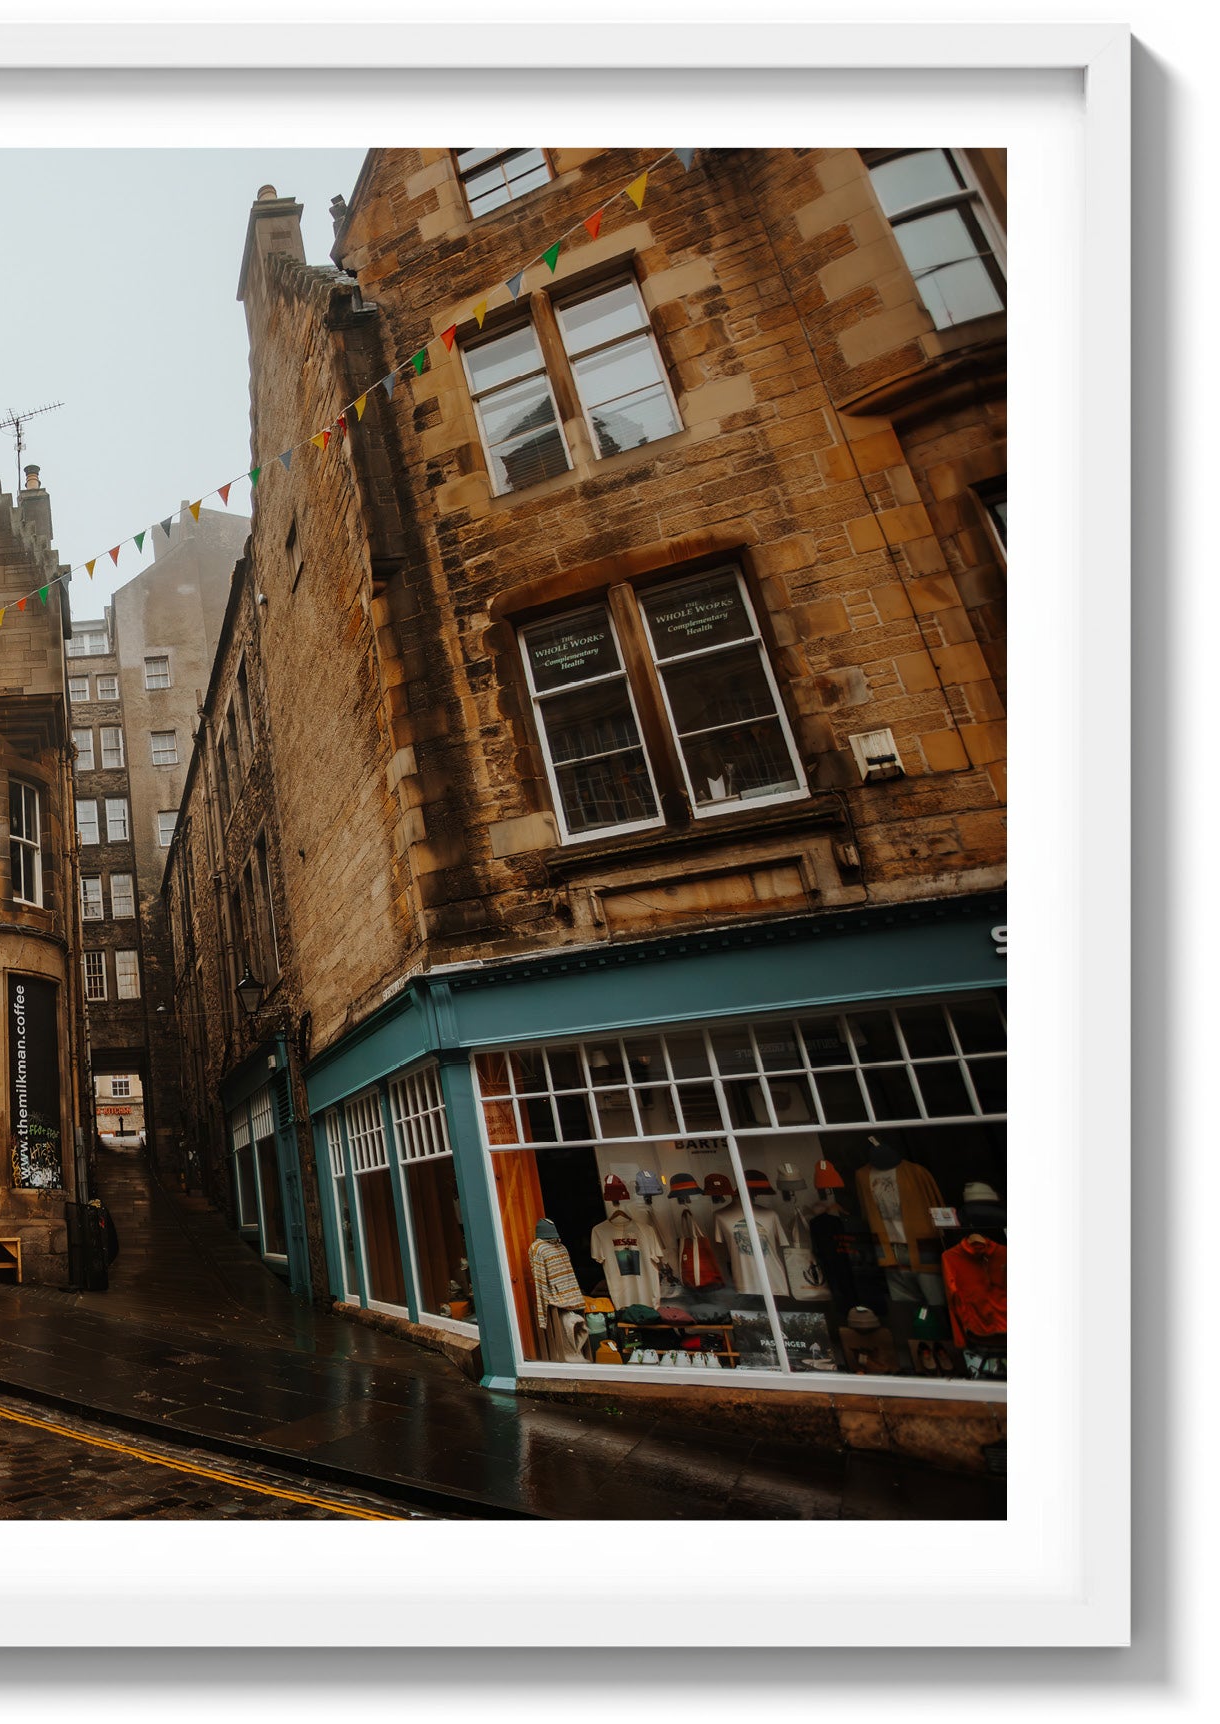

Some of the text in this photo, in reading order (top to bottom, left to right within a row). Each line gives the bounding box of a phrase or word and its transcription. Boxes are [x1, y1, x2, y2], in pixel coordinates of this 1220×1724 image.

[655, 599, 733, 623] WHOLE WORKS
[667, 613, 728, 632] Complementary
[686, 624, 713, 635] Health
[535, 633, 605, 658] WHOLE WORKS
[561, 635, 573, 643] THE
[544, 648, 599, 667] Complementary
[561, 659, 585, 670] Health
[760, 1339, 807, 1349] PASNGER
